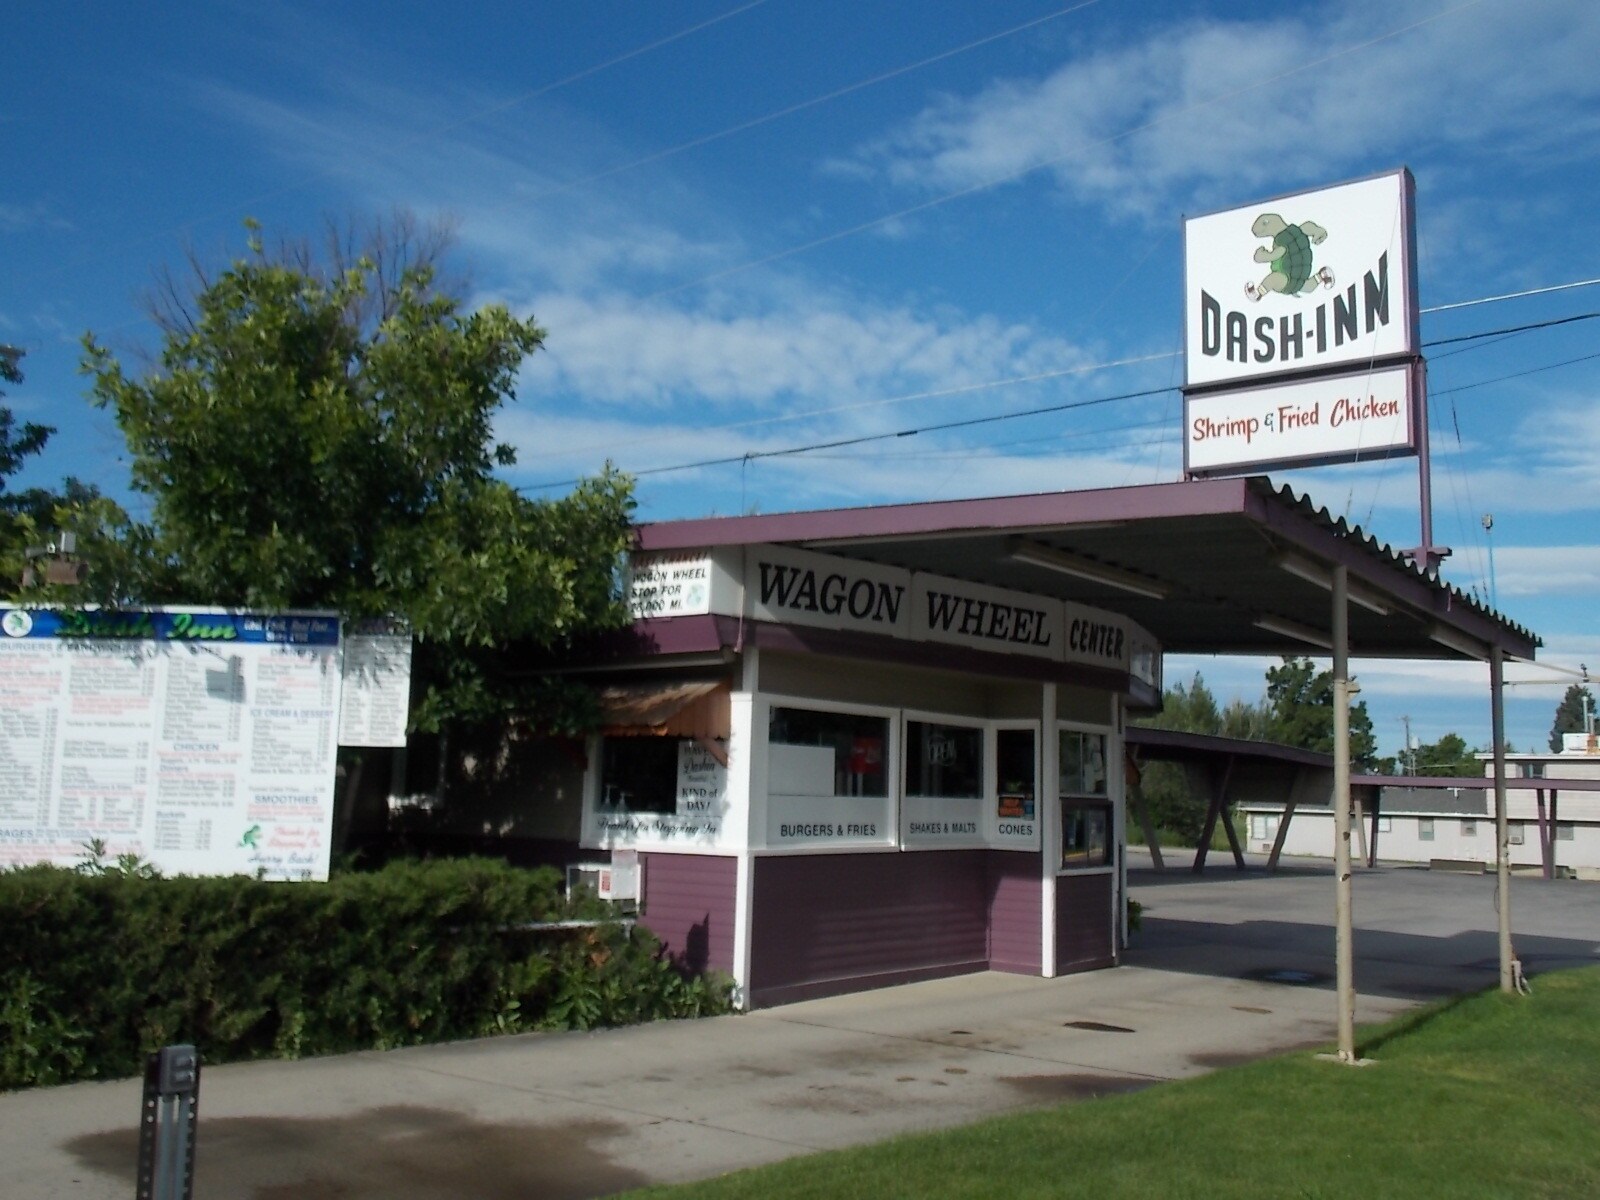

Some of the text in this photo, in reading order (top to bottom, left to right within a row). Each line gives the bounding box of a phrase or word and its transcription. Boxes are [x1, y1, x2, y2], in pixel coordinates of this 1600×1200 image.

[1201, 249, 1390, 363] DASH-INN
[1193, 416, 1259, 444] Shrimp
[1278, 402, 1319, 434] Fried
[1330, 394, 1400, 428] Chicken
[673, 568, 706, 580] WHEEL
[631, 584, 682, 599] STOP FOR
[758, 562, 1125, 660] WAGON WHEEL CENTER
[269, 709, 293, 718] CREAM
[174, 743, 219, 751] CHICKEN
[682, 788, 718, 798] KIND of
[255, 795, 318, 804] SMOOTHIES
[687, 801, 710, 811] DAY!
[598, 817, 633, 831] Thanks
[655, 820, 699, 836] Stopping
[703, 823, 716, 834] In
[781, 824, 876, 837] BURGERS & FRIES
[909, 822, 976, 834] SHAKES & MALTS
[998, 824, 1033, 836] CONES
